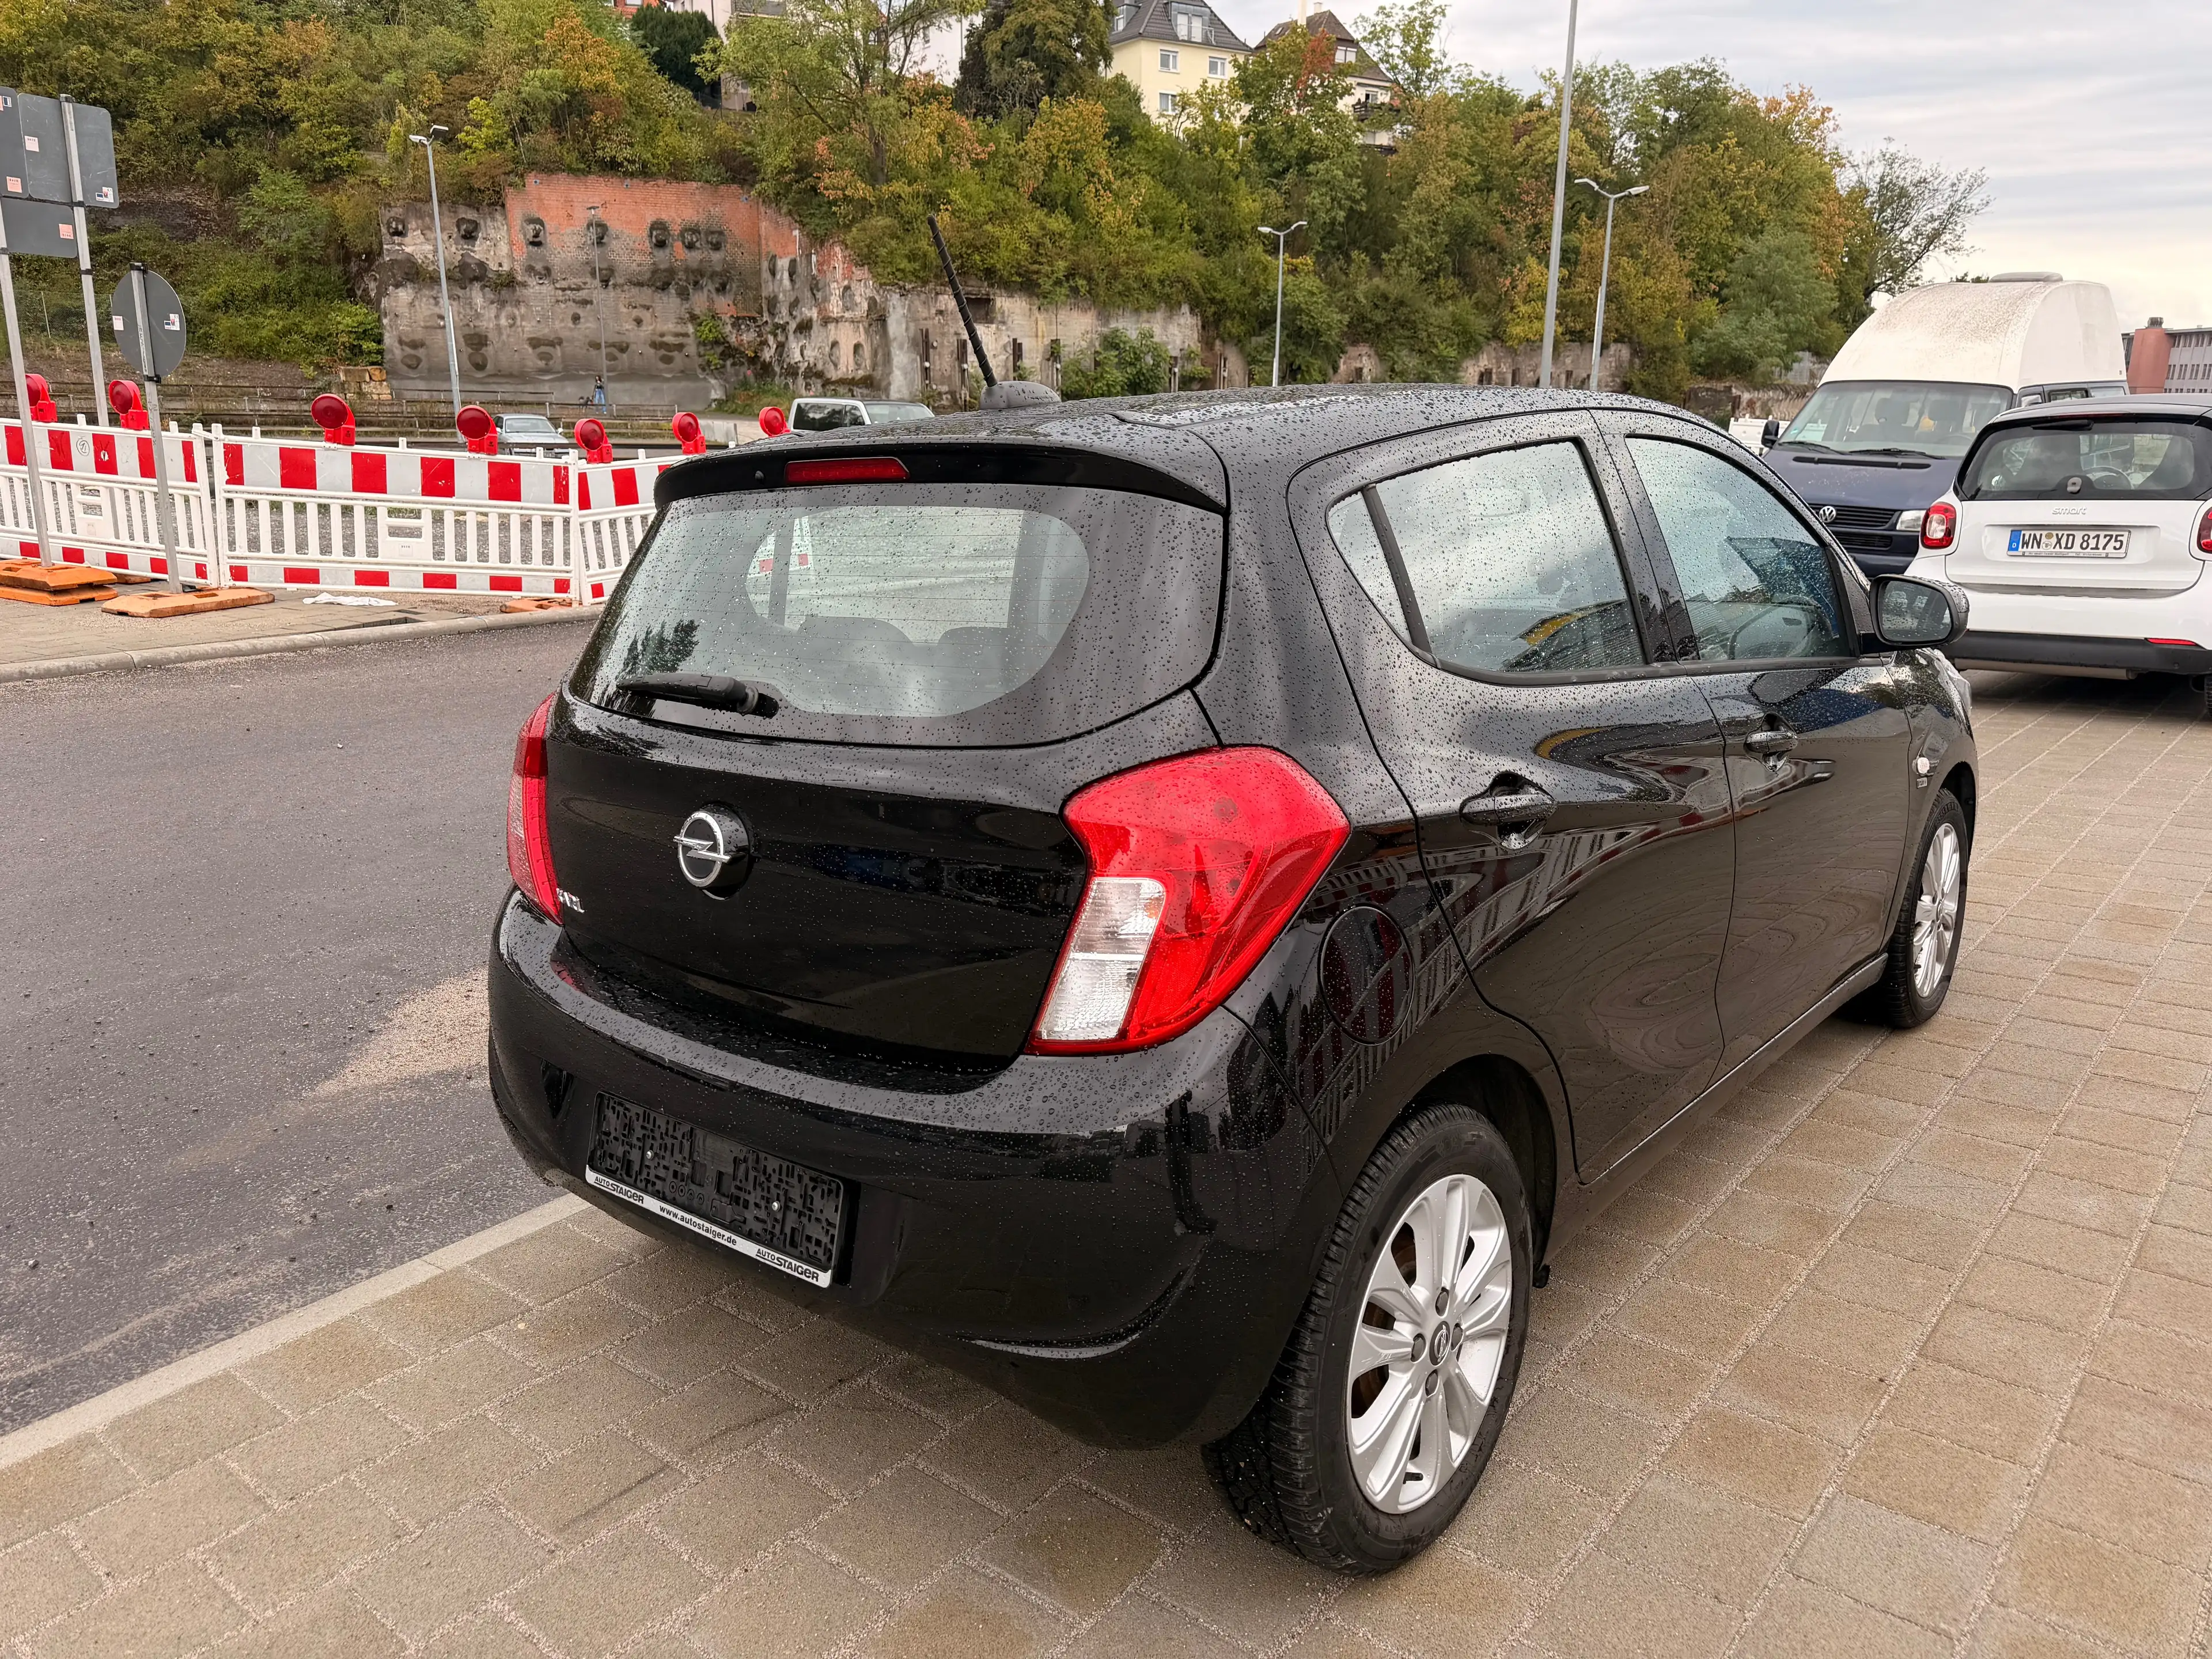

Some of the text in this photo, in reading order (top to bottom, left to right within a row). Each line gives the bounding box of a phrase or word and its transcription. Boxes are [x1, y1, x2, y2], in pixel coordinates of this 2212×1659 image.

[2051, 506, 2086, 515] smart
[2021, 533, 2124, 551] WN XD 8175
[659, 1205, 737, 1246] www.autostaiger.de
